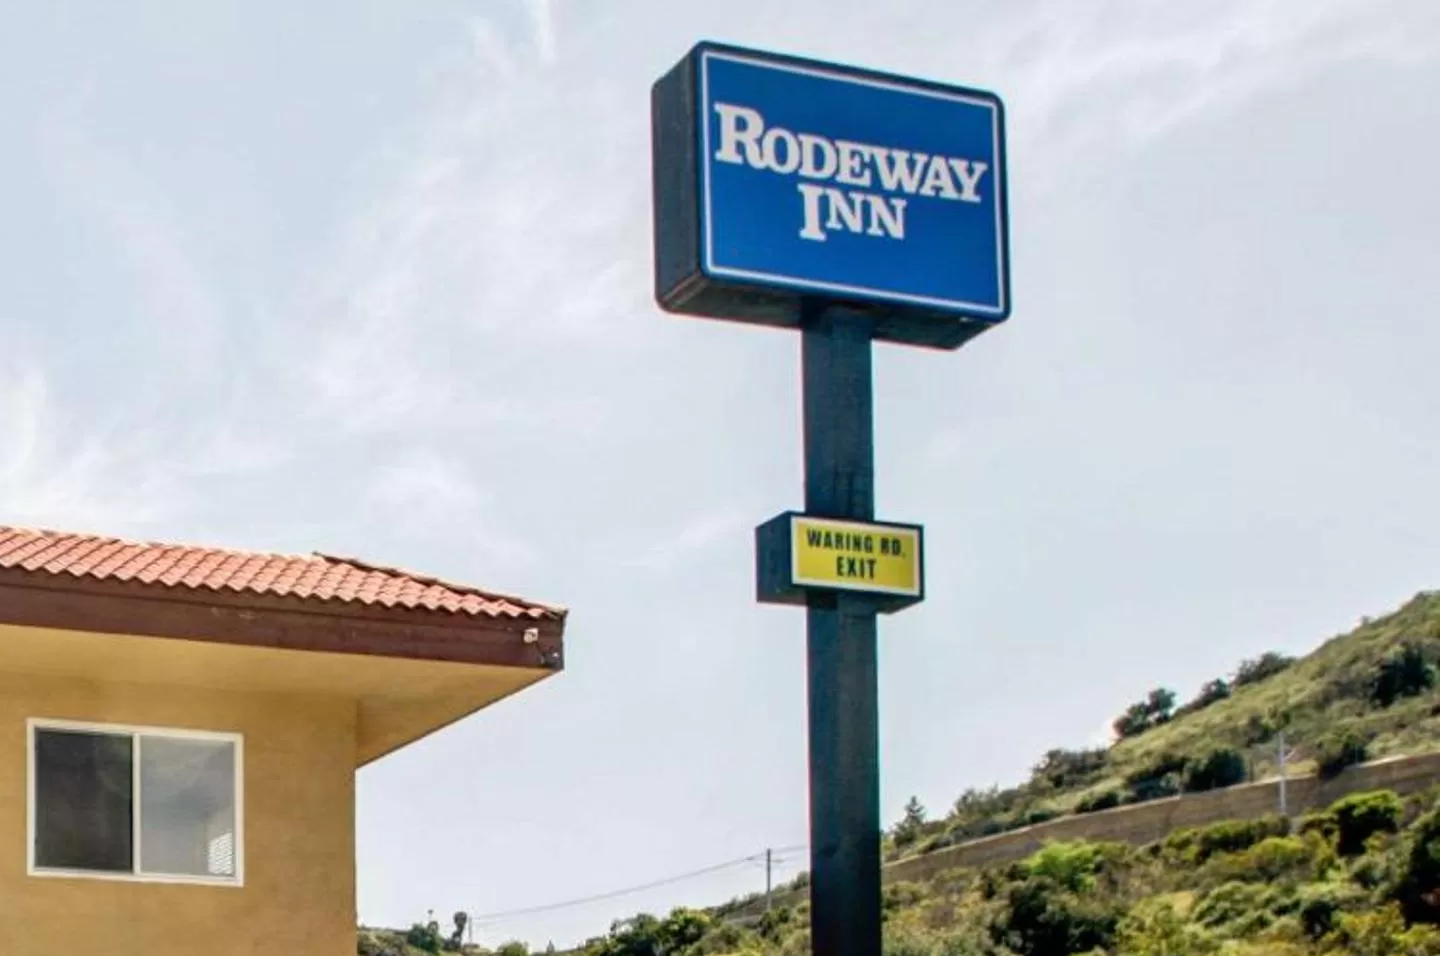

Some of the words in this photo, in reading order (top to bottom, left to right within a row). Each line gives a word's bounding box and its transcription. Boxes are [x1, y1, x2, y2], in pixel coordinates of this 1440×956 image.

[713, 102, 987, 202] RODEWAY
[797, 183, 907, 241] INN
[806, 528, 873, 553] WARING
[836, 555, 877, 580] EXIT
